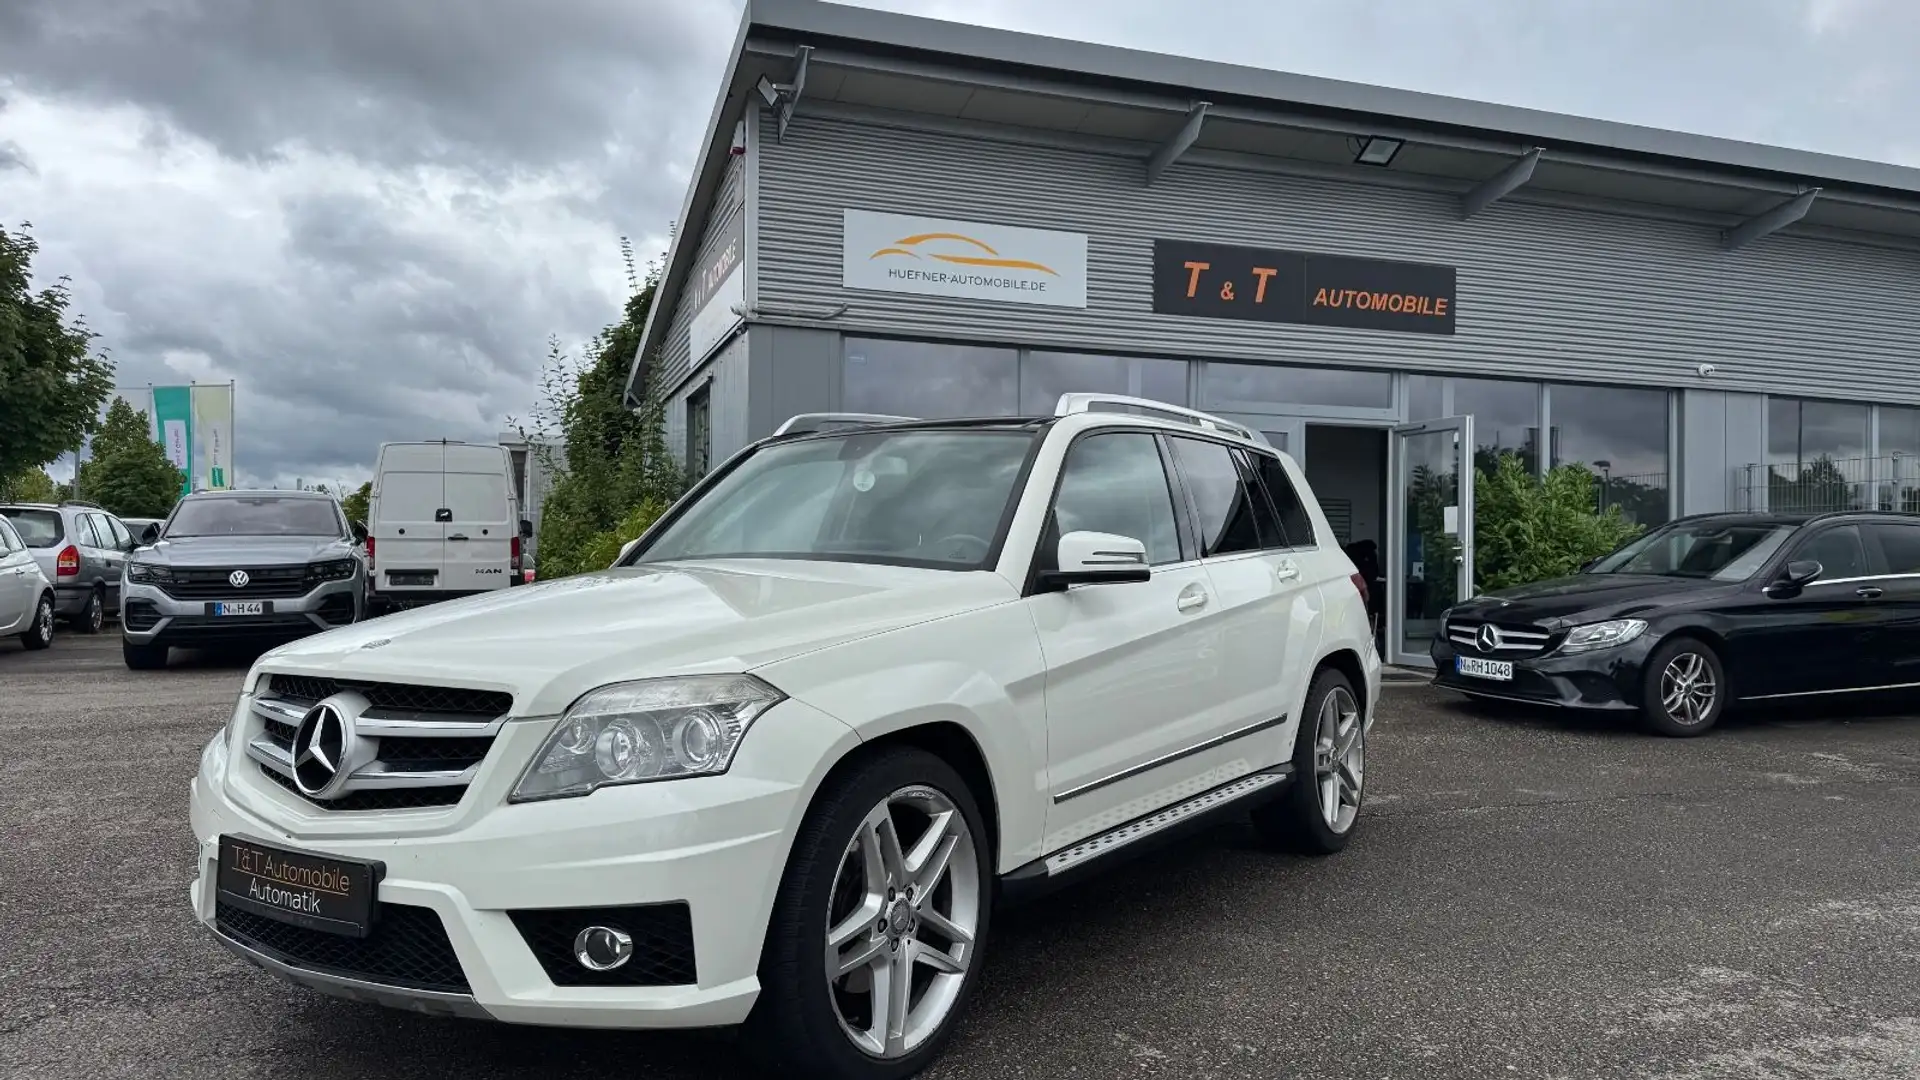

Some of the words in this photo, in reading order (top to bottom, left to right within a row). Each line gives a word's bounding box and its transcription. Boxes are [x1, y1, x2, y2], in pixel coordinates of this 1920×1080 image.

[888, 268, 1047, 292] HUEFNER-AUTOMOBILE.DE
[1184, 261, 1211, 298] T
[1220, 280, 1235, 301] &
[1252, 266, 1278, 303] T
[1313, 287, 1449, 316] AUTOMOBILE
[231, 844, 264, 872] T&T
[264, 855, 350, 891] Automobile
[248, 877, 321, 913] Automatik
